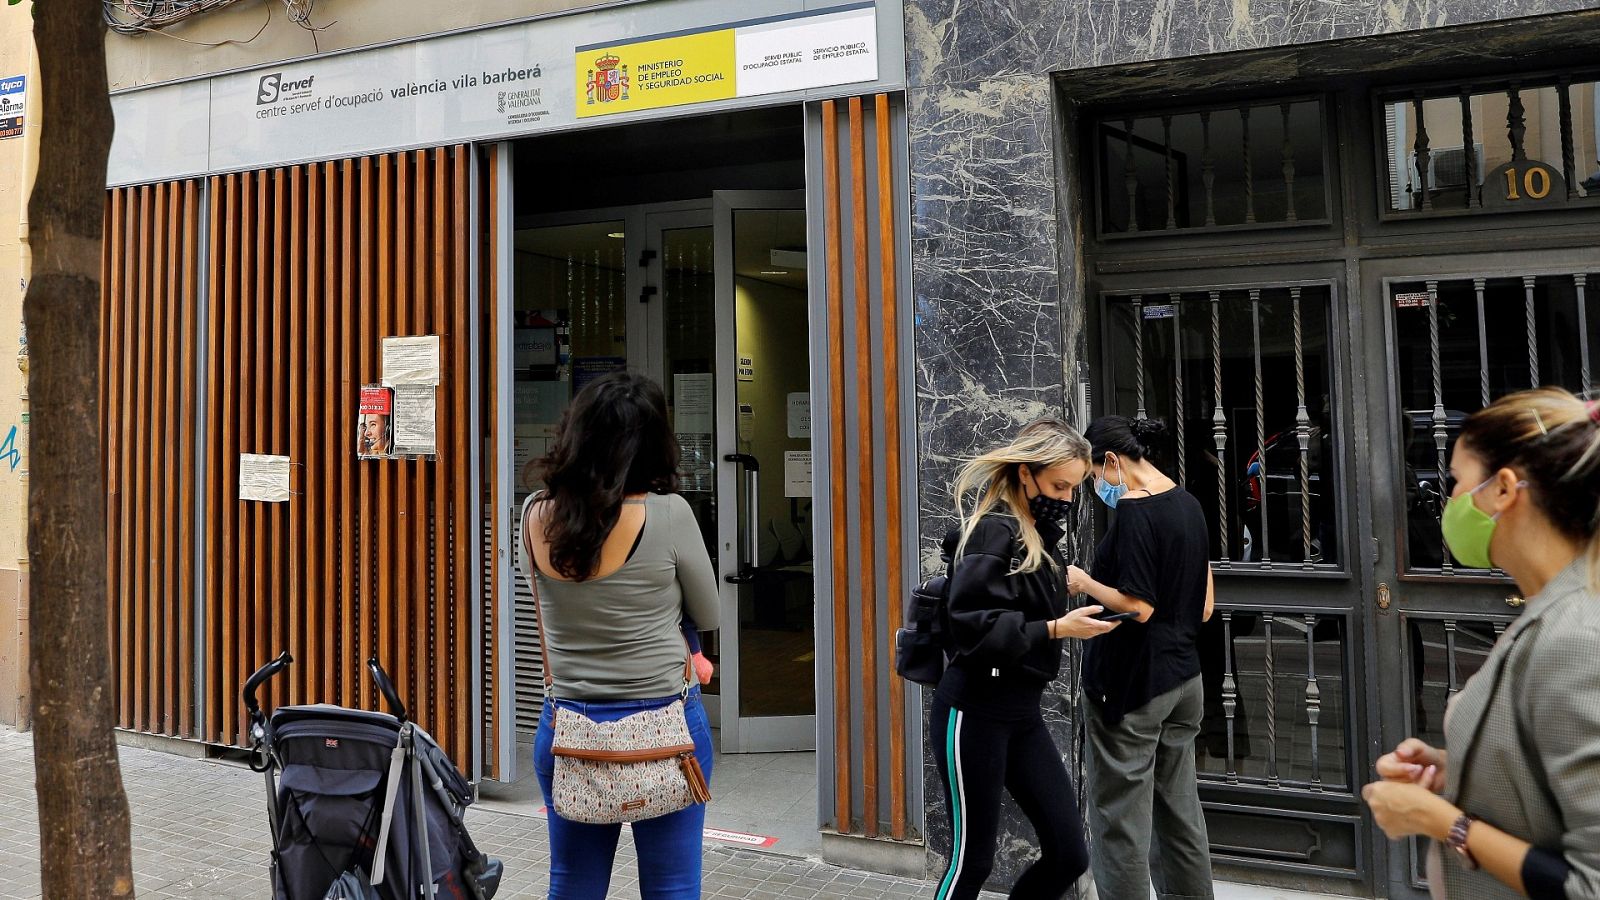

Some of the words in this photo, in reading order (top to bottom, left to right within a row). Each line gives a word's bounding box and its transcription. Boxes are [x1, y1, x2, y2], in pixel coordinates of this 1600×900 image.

[813, 45, 839, 55] SERVICIO
[822, 51, 845, 60] EMPLEO
[845, 48, 870, 57] ESTATAL
[764, 54, 782, 62] SERVEI
[779, 57, 802, 66] ESTATAL
[637, 59, 684, 73] MINISTERIO
[637, 73, 649, 82] DE
[650, 69, 682, 80] EMPLEO
[637, 83, 644, 91] Y
[645, 77, 693, 90] SEGURIDAD
[693, 72, 725, 84] SOCIAL
[1, 81, 23, 91] tyco
[255, 105, 287, 120] centre
[290, 97, 322, 115] servef
[324, 88, 384, 109] d'ocupació
[390, 79, 447, 99] valència
[452, 74, 477, 90] vila
[482, 63, 542, 85] barberá
[256, 73, 315, 106] Servef
[507, 87, 542, 101] GENERALITAT
[507, 97, 542, 109] VALENCIANA
[1503, 166, 1551, 200] 10
